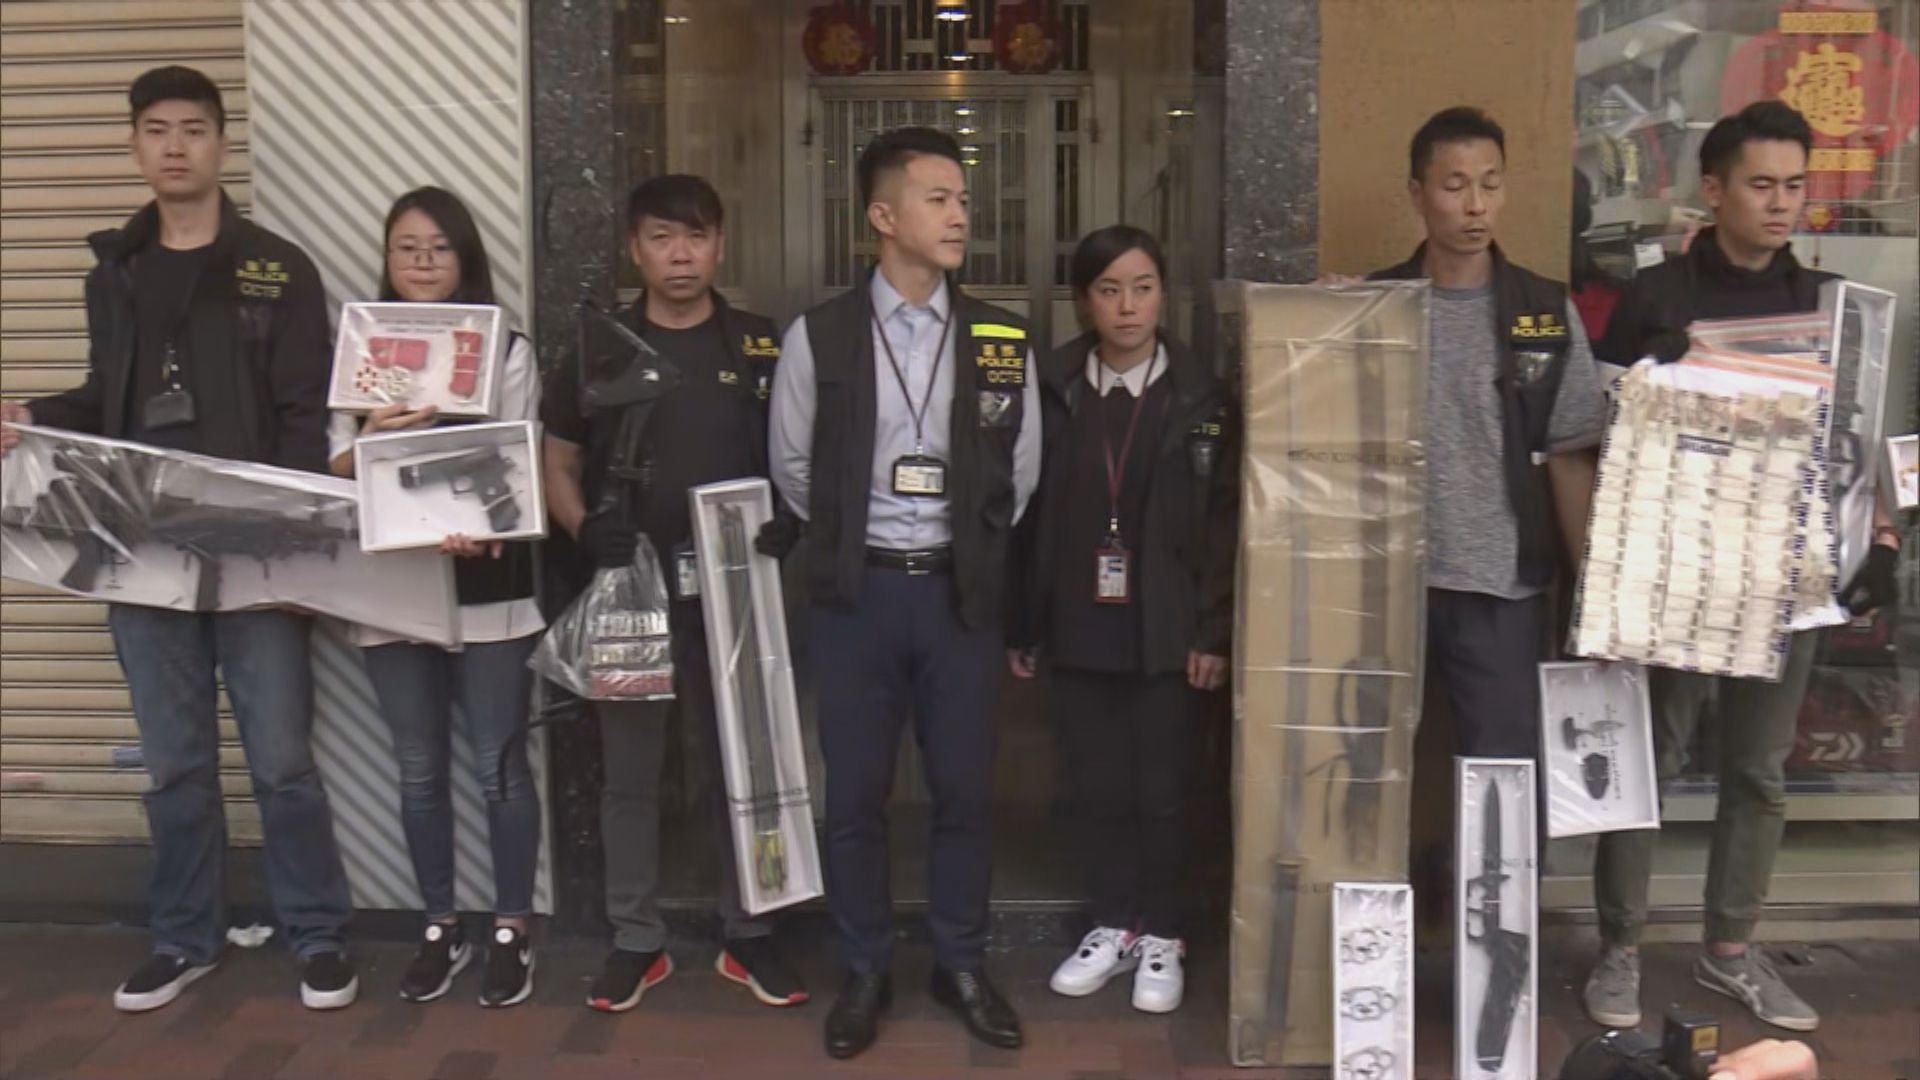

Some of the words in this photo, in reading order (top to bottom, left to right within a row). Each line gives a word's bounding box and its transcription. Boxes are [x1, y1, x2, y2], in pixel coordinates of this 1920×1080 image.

[1511, 326, 1566, 337] POLICE
[976, 356, 1024, 368] POLICE
[986, 370, 1024, 383] OCTB
